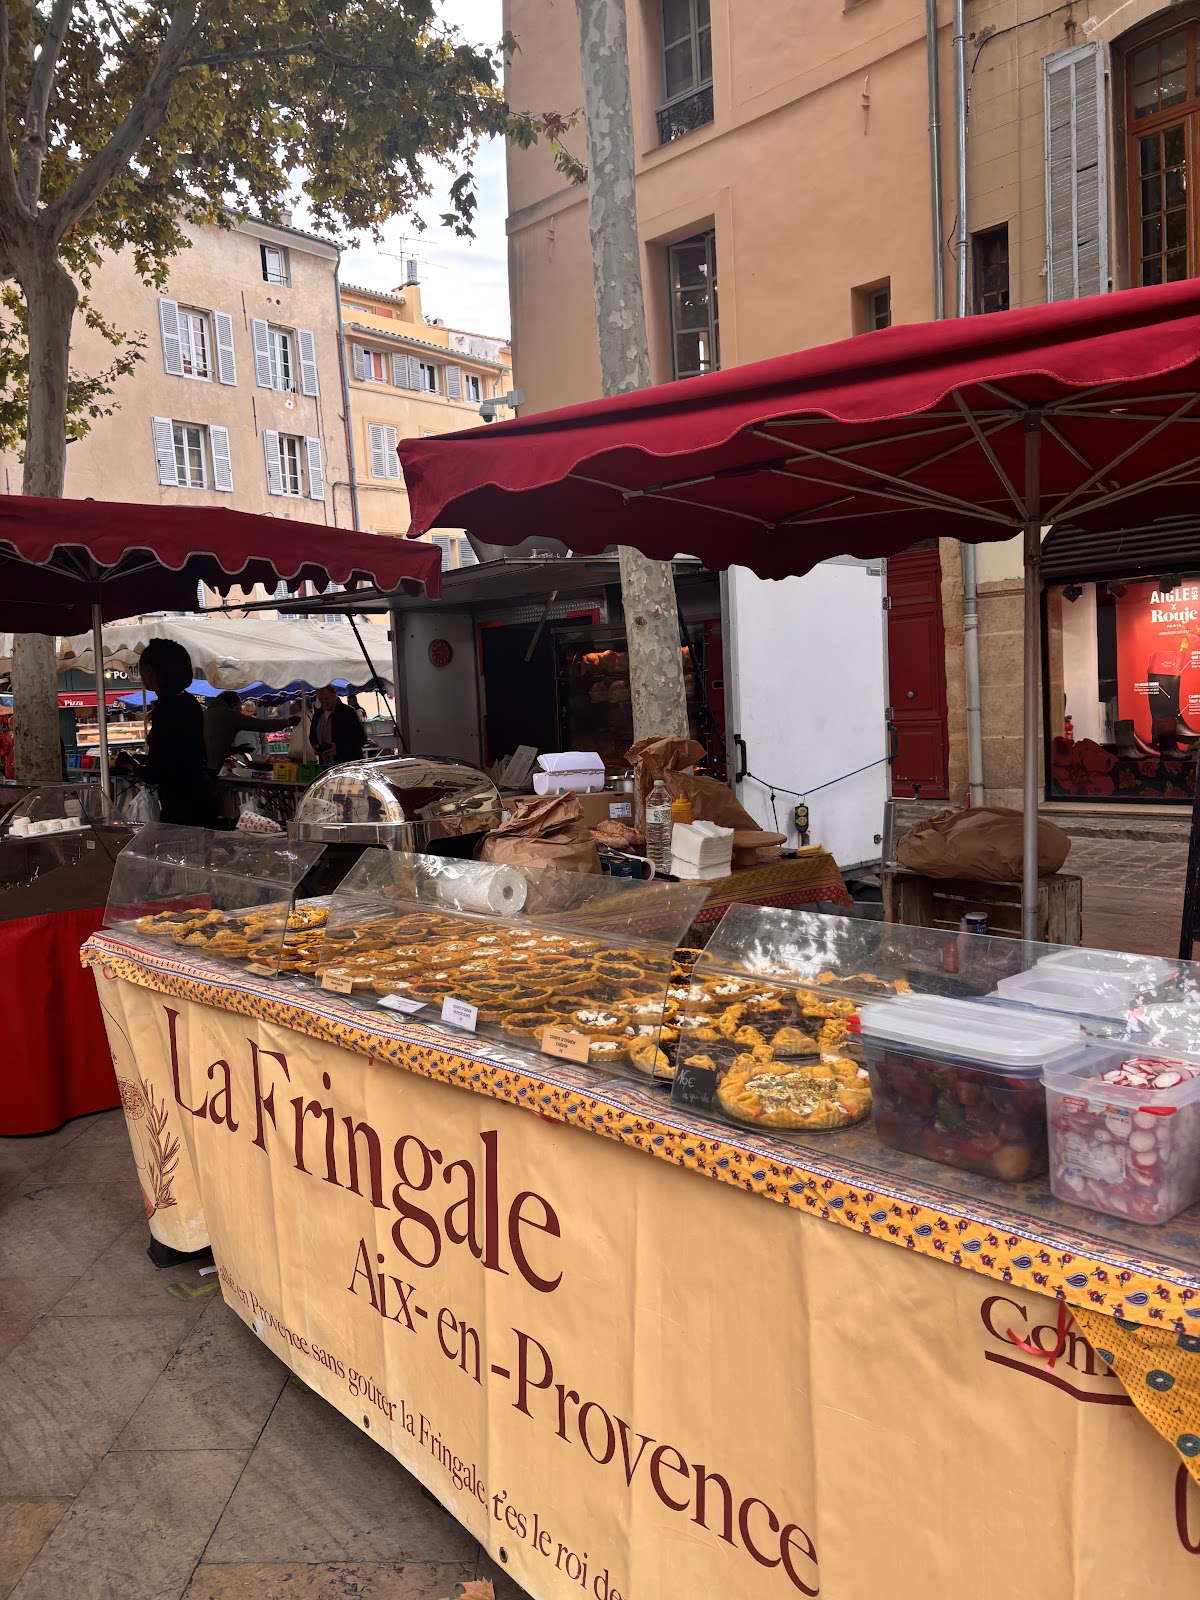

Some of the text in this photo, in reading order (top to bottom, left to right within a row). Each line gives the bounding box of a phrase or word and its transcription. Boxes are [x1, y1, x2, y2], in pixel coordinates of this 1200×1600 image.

[1150, 588, 1190, 604] AIGLE
[1151, 607, 1198, 624] Rouje
[113, 671, 130, 680] PO
[163, 1005, 563, 1293] La Fringale
[236, 1285, 250, 1308] en
[249, 1290, 310, 1355] Provence
[311, 1343, 345, 1379] sans
[348, 1367, 397, 1422] goûter
[400, 1400, 416, 1437] la
[418, 1412, 489, 1515] Fringale,
[531, 1513, 552, 1557] le
[554, 1543, 588, 1590] roi
